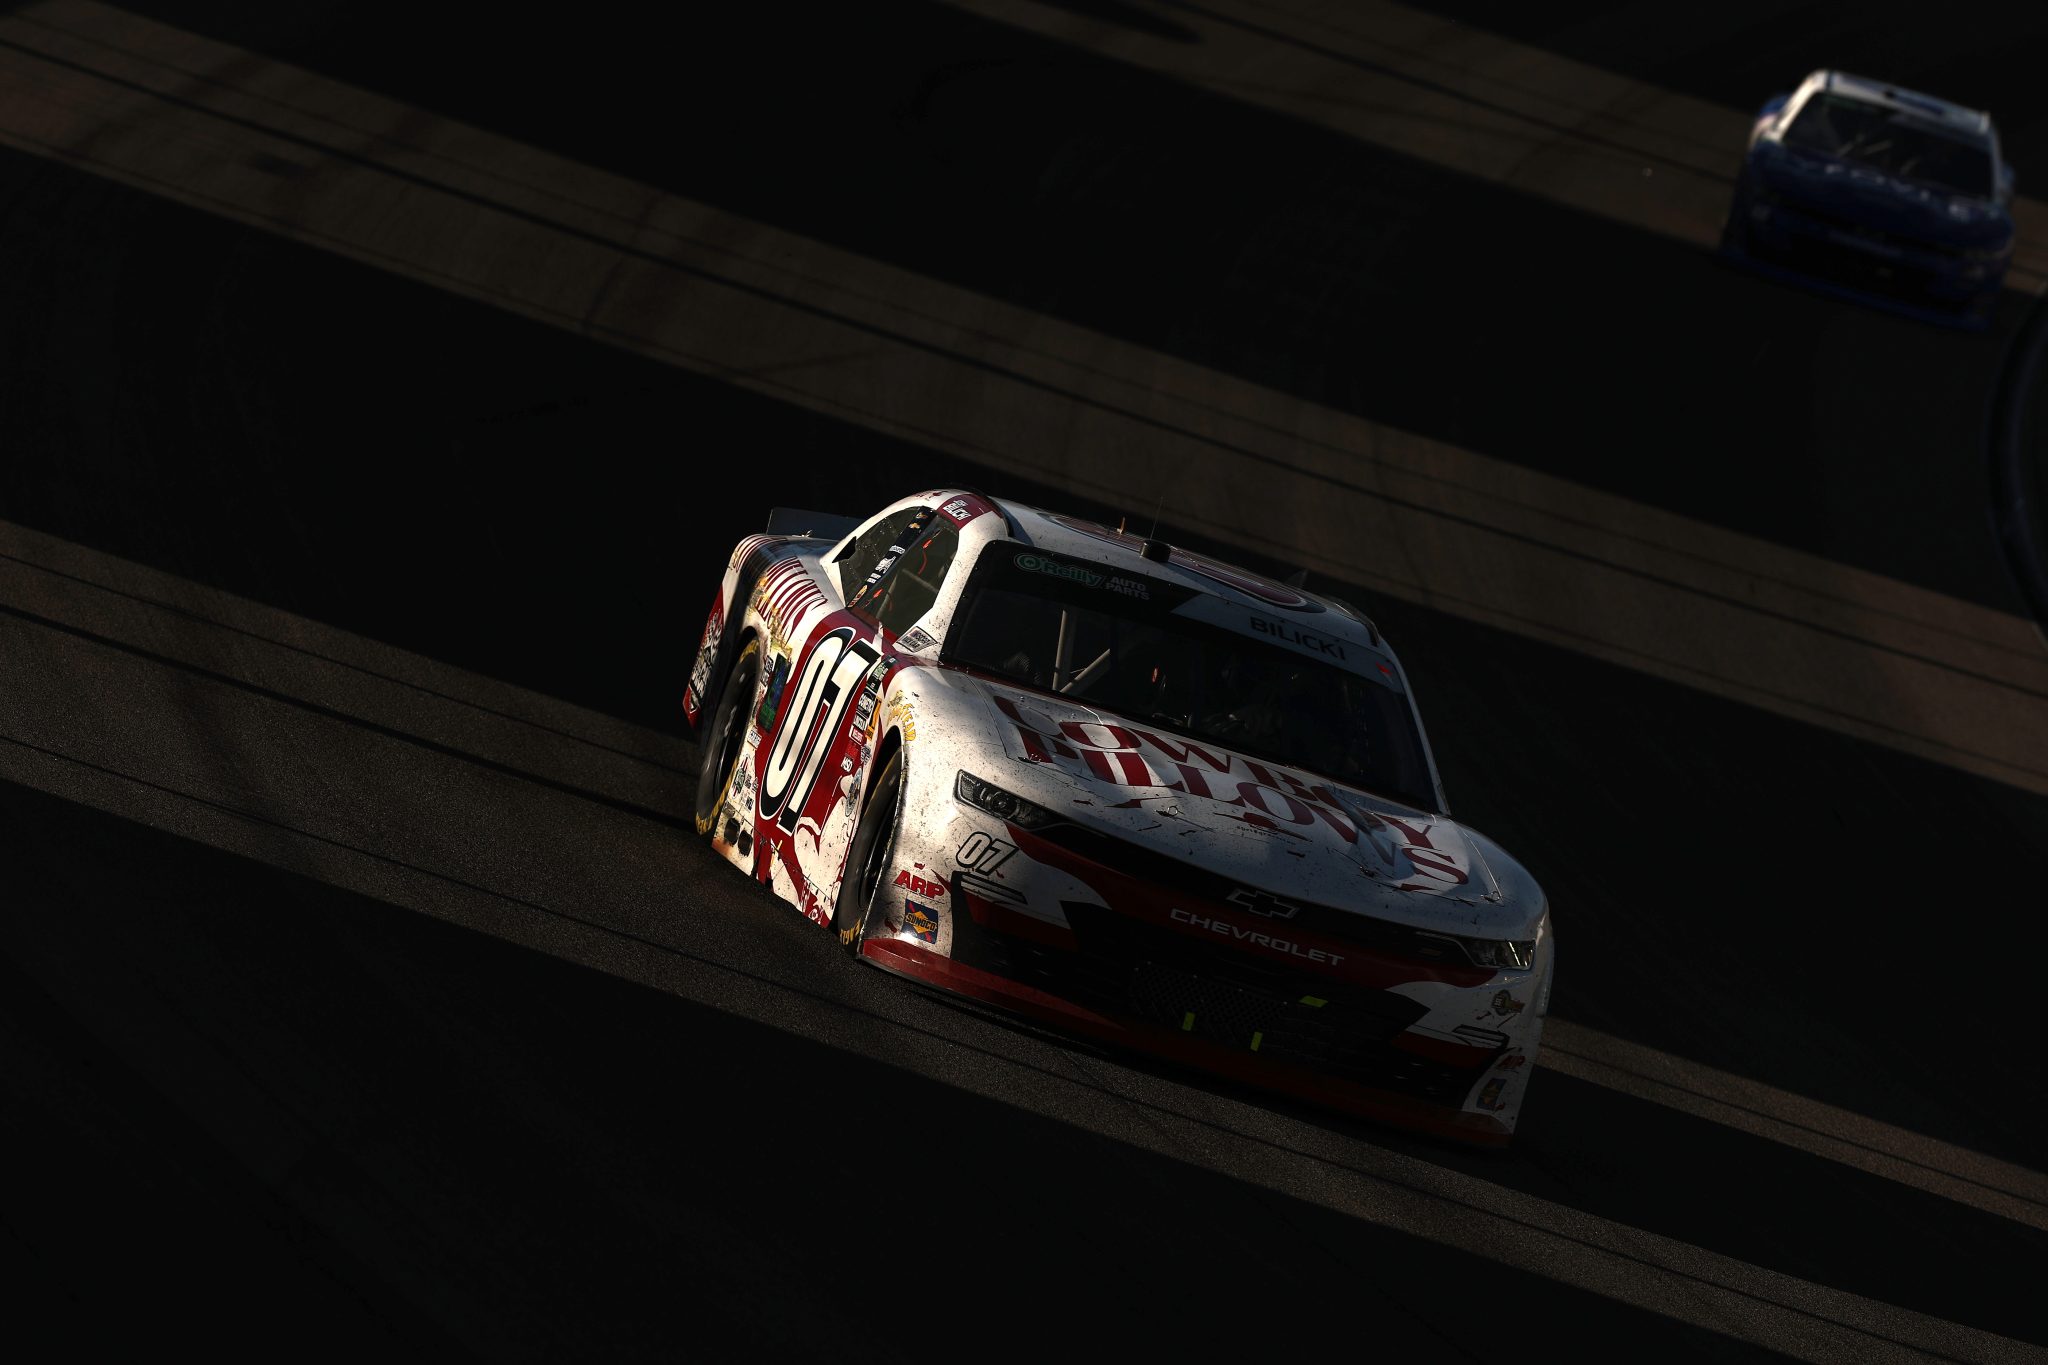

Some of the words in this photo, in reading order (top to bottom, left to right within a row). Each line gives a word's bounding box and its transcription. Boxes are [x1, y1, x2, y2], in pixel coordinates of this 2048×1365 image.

[1013, 552, 1104, 589] O'Reilly
[1110, 576, 1147, 591] AUTO
[1105, 582, 1151, 601] PARTS
[1249, 616, 1346, 660] BILICKI
[994, 694, 1435, 850] COWBOY
[1009, 722, 1470, 886] PILLOWS
[956, 831, 1019, 876] 07
[893, 870, 945, 899] ARP
[905, 912, 938, 932] SUNOCO
[1170, 908, 1345, 966] CHEVROLET
